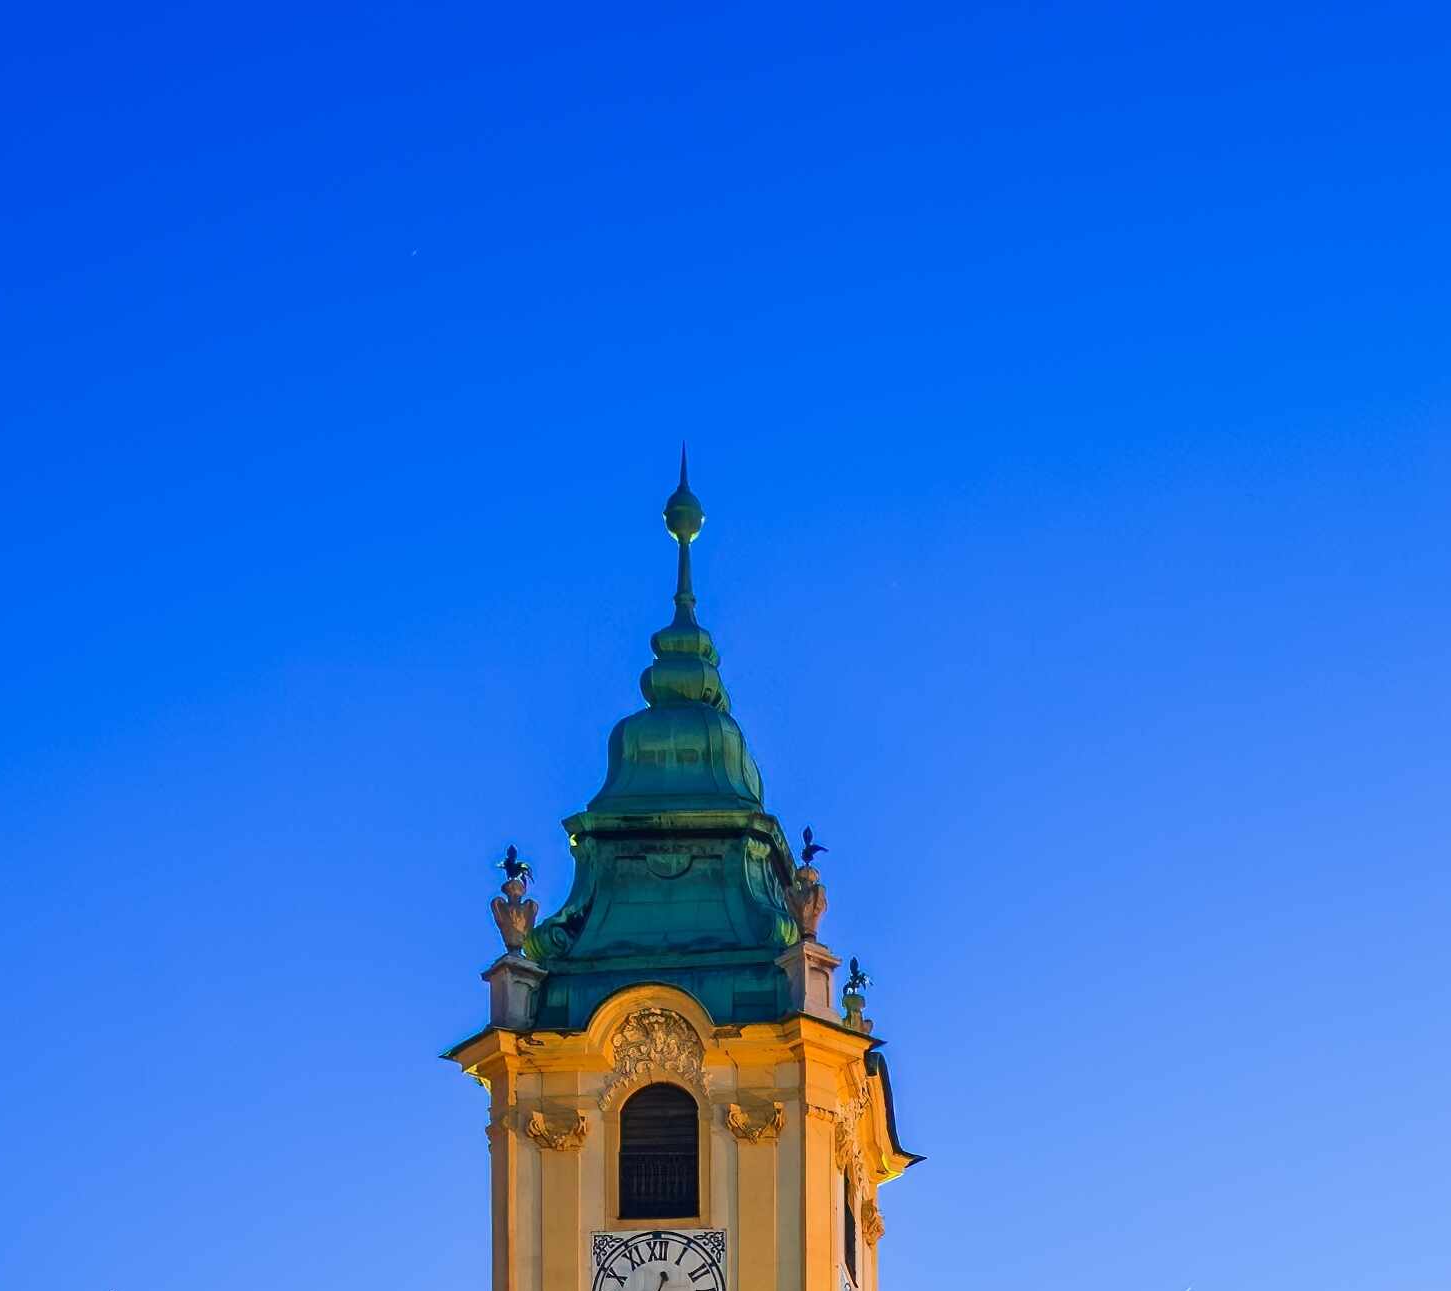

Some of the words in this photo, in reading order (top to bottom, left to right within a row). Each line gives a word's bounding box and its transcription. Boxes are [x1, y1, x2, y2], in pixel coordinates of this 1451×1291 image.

[622, 1245, 646, 1271] XI
[646, 1241, 669, 1262] XII
[675, 1247, 689, 1266] I
[606, 1266, 628, 1288] X
[688, 1263, 711, 1283] II
